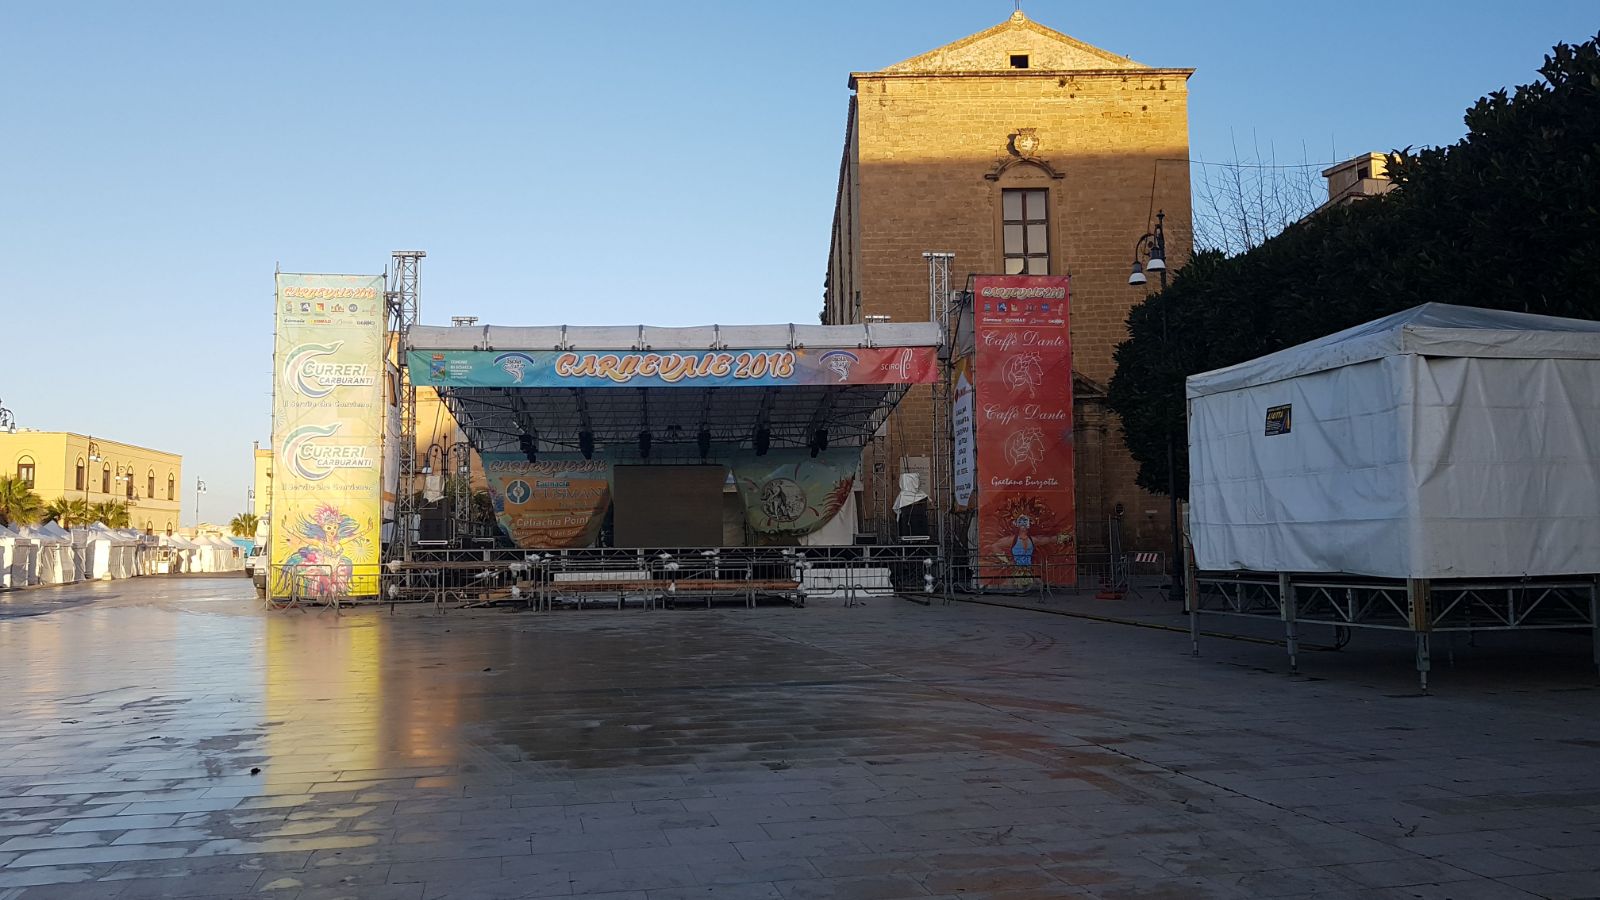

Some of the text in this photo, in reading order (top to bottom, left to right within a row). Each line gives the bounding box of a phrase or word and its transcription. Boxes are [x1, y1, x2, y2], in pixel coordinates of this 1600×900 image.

[1022, 330, 1065, 346] Dante
[302, 360, 367, 376] CURRERI
[555, 353, 735, 383] CARNEVALE
[733, 351, 796, 379] 2018
[319, 376, 374, 385] CARBURANTI
[1023, 403, 1067, 420] Dante
[300, 444, 366, 458] CURRERI
[317, 458, 372, 467] CARBURANTI
[990, 475, 1024, 486] Gaetano
